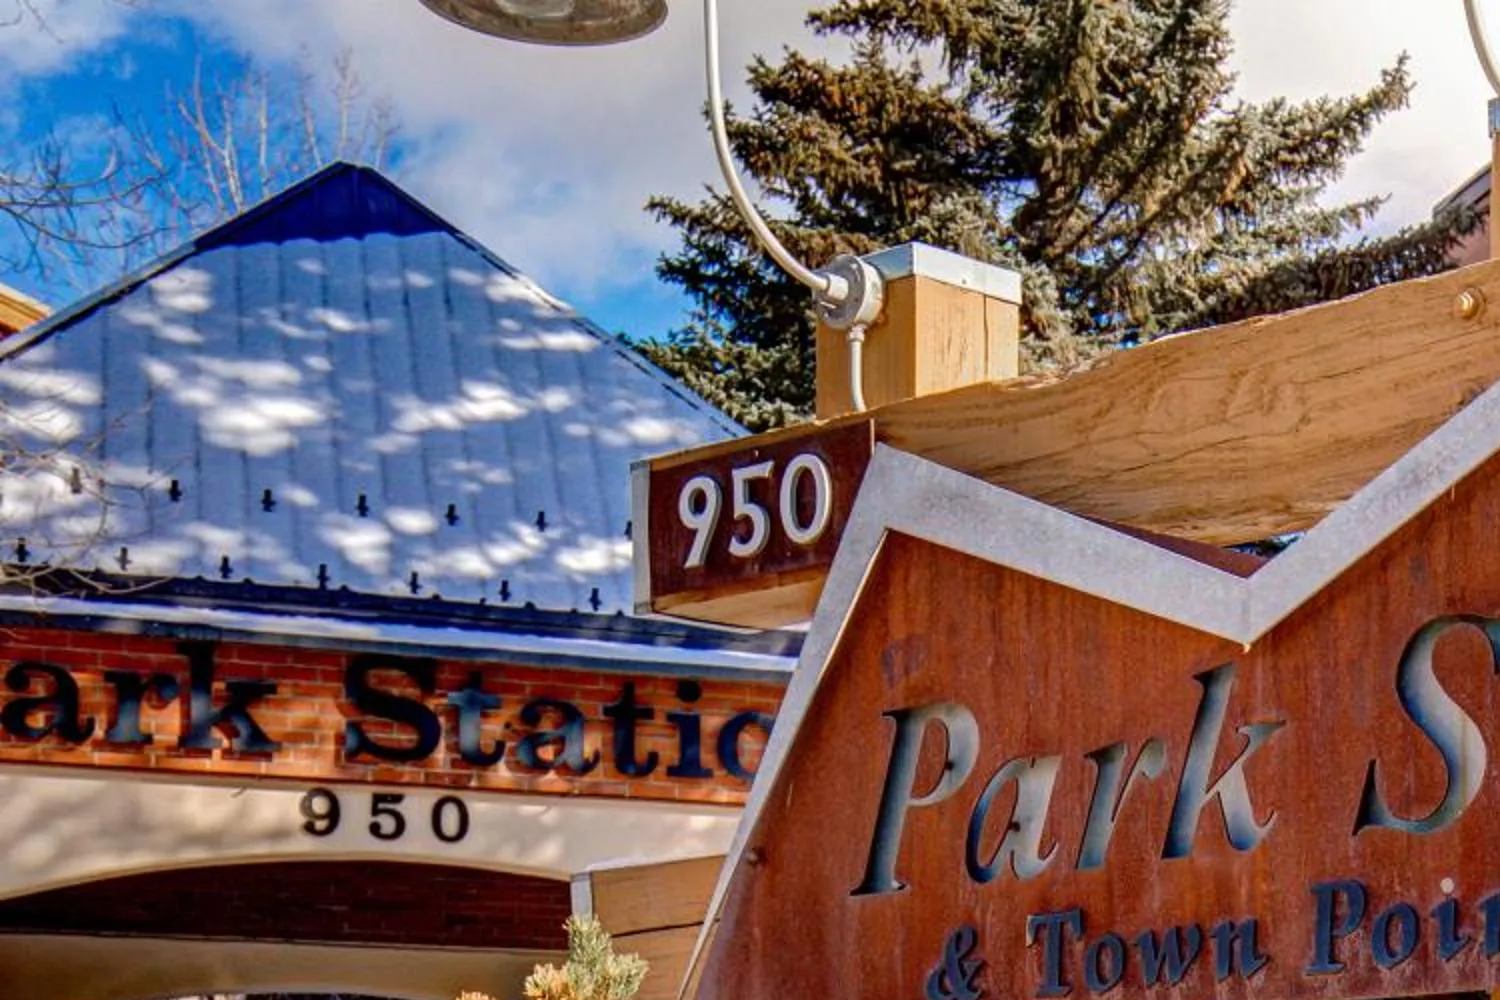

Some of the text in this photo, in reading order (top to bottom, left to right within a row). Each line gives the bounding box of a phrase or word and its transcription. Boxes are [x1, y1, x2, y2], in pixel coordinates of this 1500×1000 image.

[678, 453, 832, 569] 950
[302, 788, 470, 842] 950
[850, 661, 1286, 897] Park
[1028, 907, 1269, 999] Town
